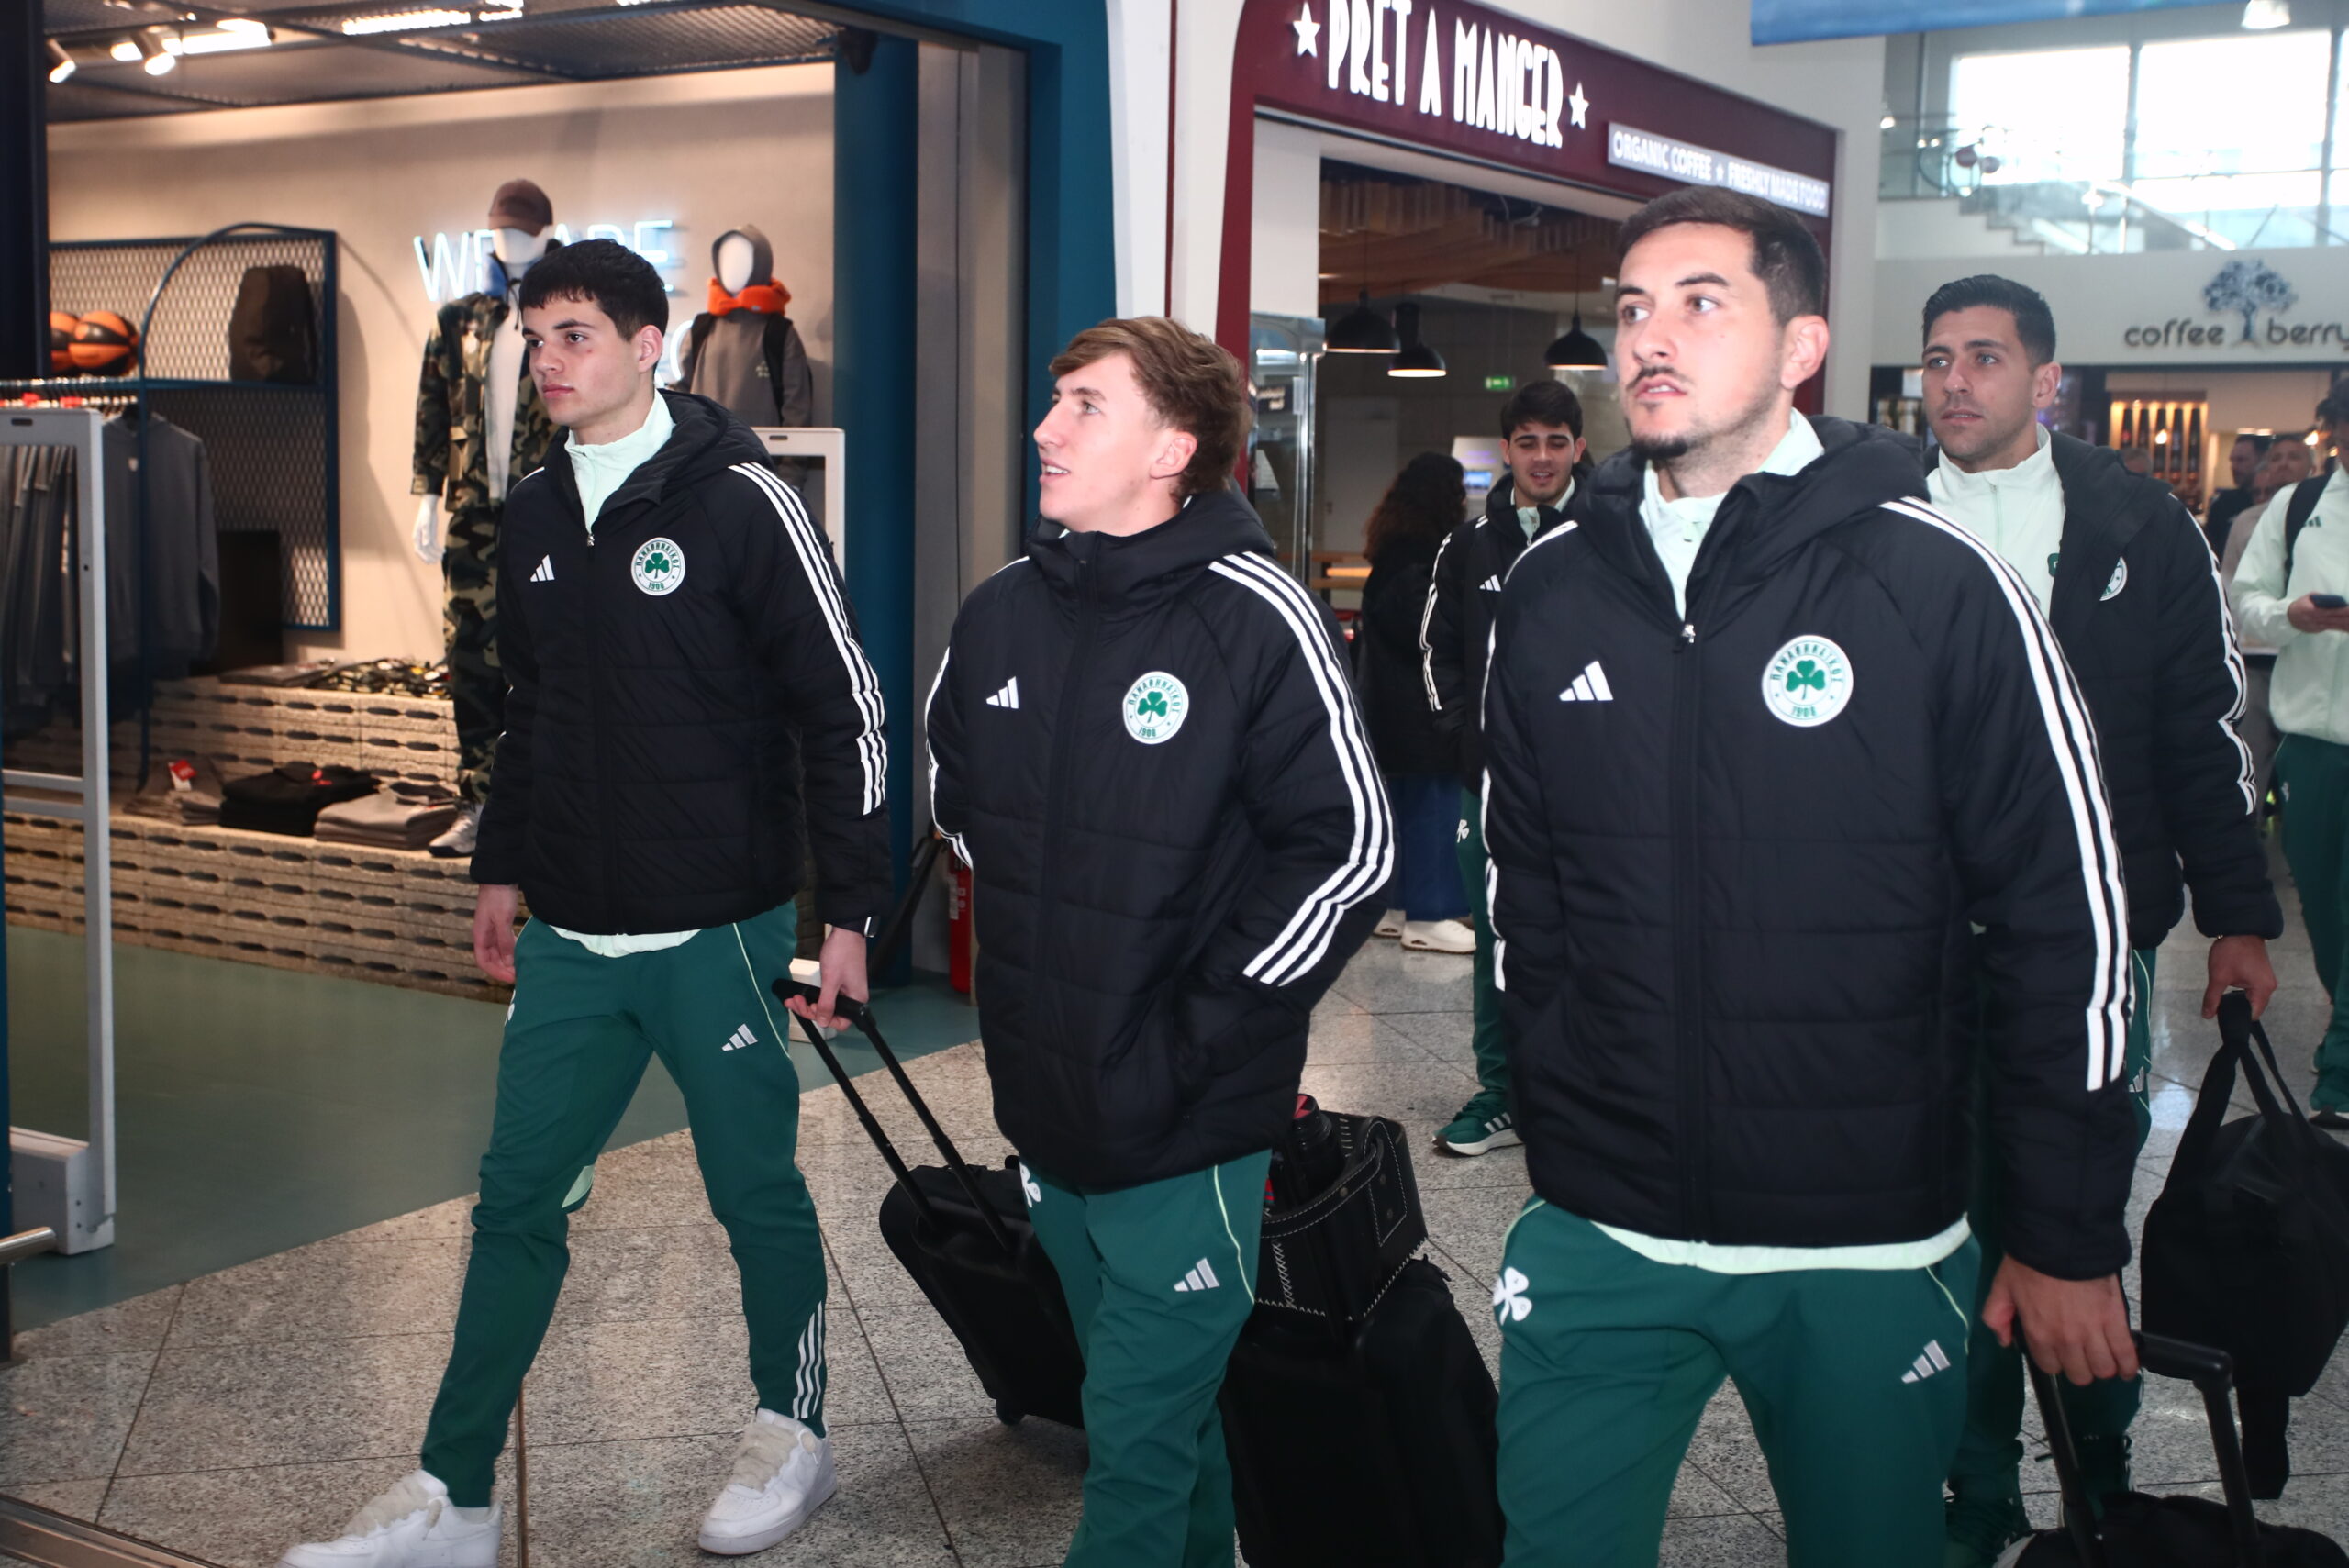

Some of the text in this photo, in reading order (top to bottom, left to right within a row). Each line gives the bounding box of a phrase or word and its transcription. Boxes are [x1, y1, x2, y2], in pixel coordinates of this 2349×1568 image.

[1328, 0, 1564, 149] PRET A MANGER
[1612, 130, 1826, 210] ORGANIC COFFEE FRESHLY MADE FOOD
[2124, 318, 2224, 347] coffee
[648, 582, 665, 590] 1908
